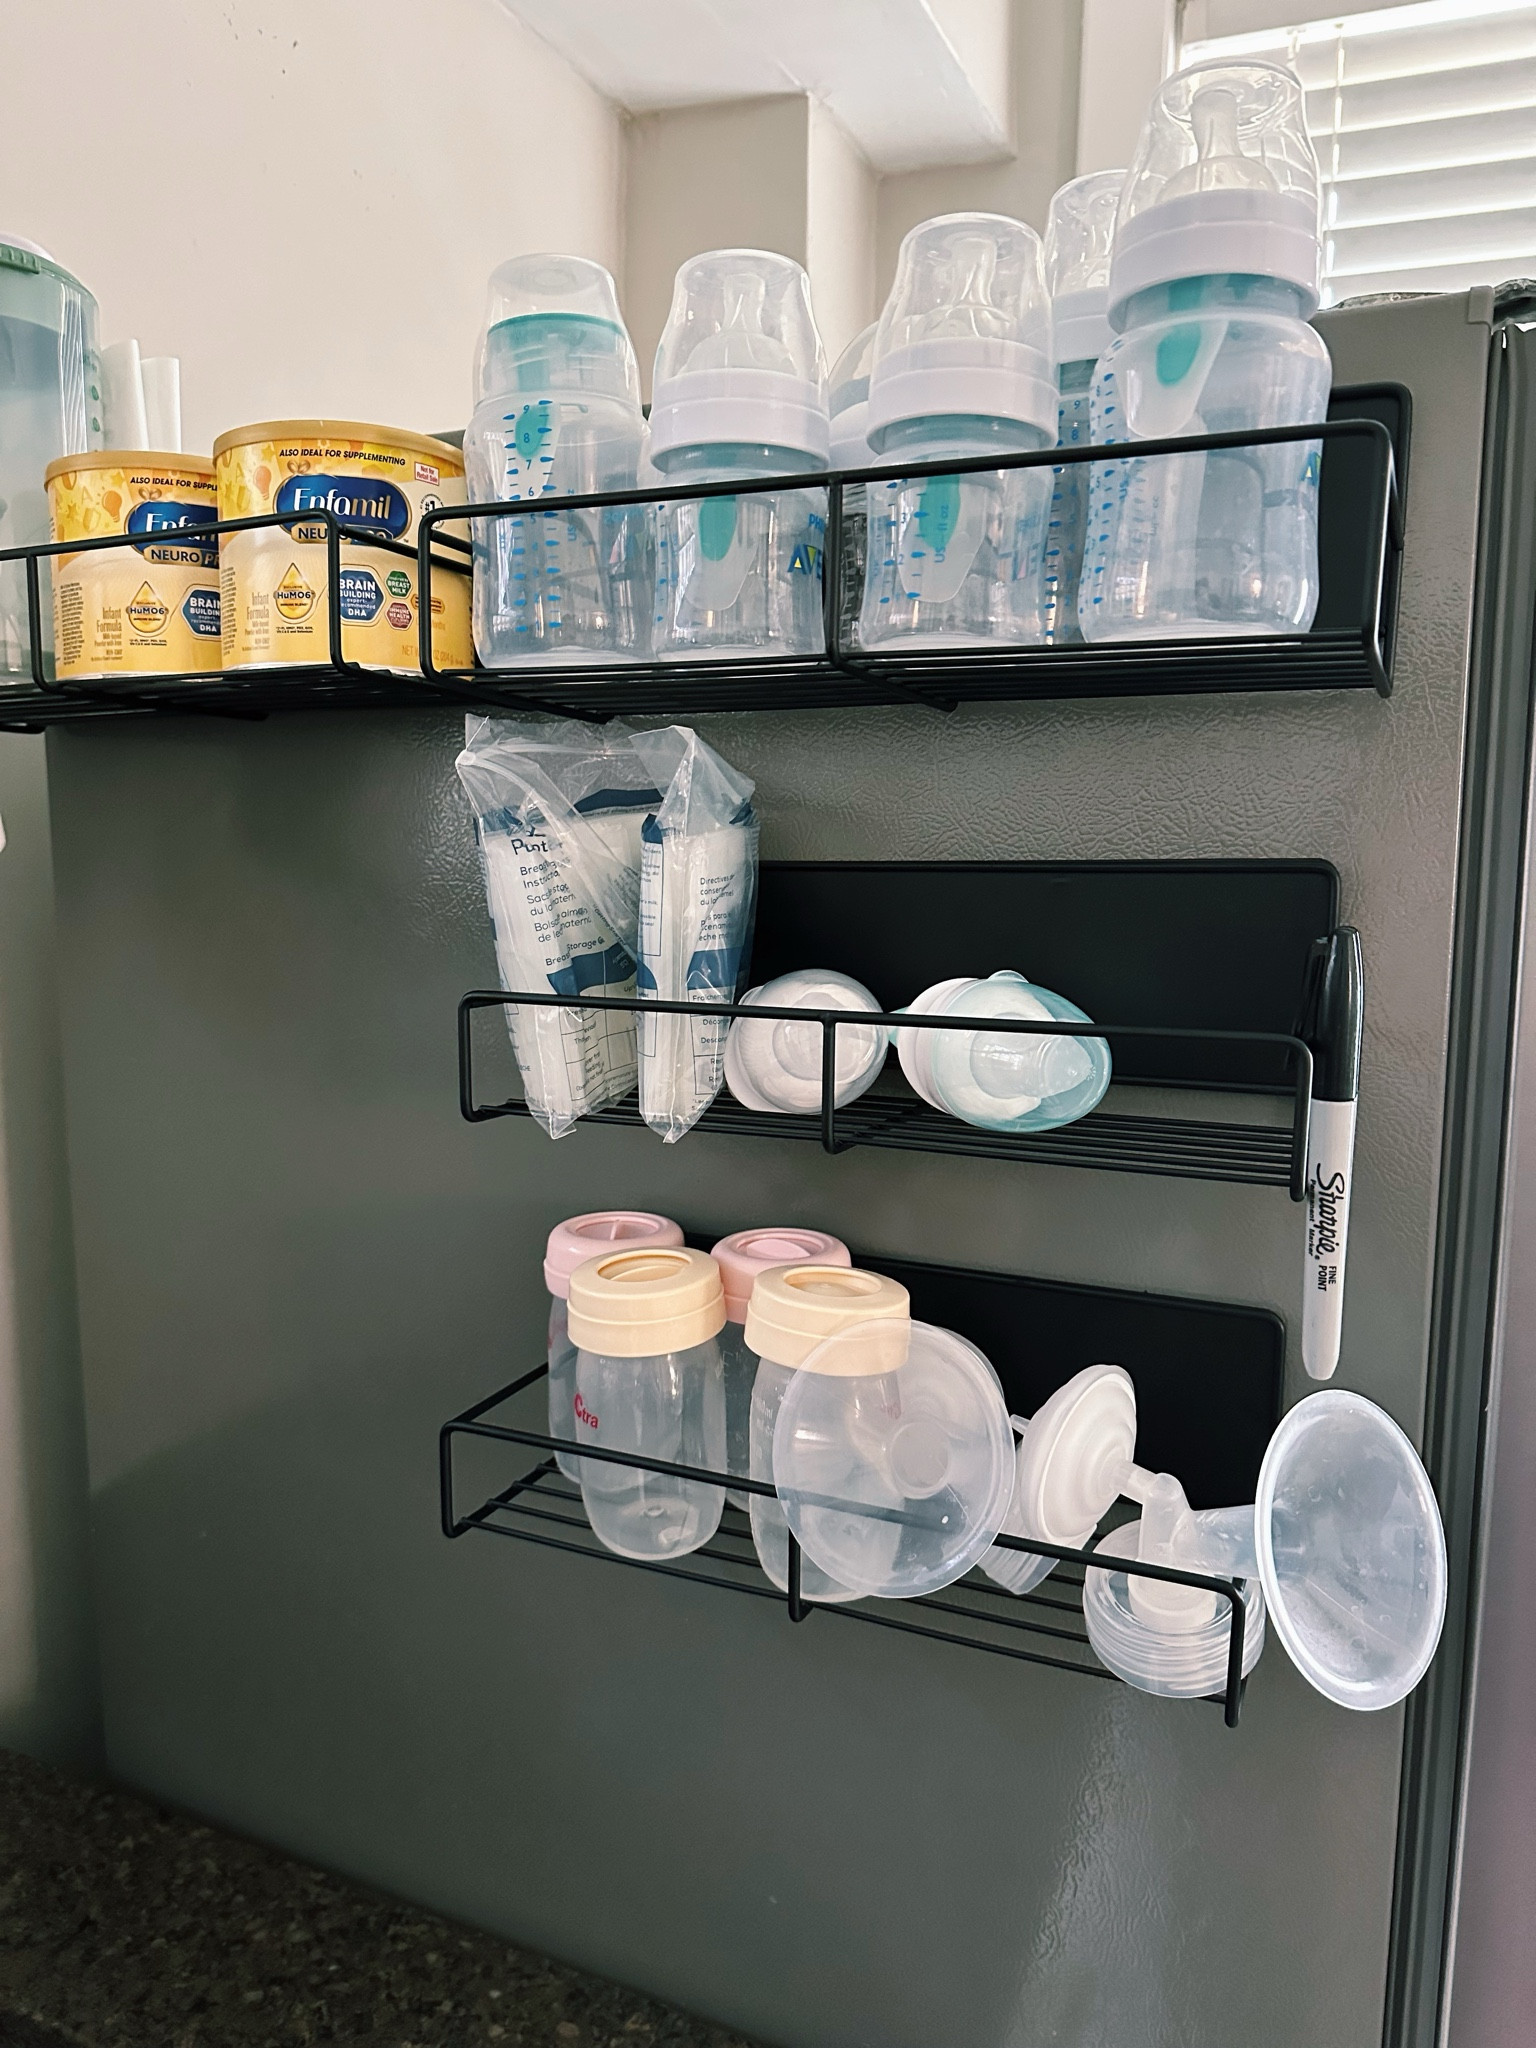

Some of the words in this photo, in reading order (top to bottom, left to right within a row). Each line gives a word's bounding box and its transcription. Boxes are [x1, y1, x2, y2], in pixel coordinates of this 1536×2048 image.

[523, 404, 530, 414] 9
[523, 432, 531, 444] 8
[1071, 428, 1079, 440] 8
[279, 449, 299, 458] ALSO
[301, 448, 323, 457] IDEAL
[325, 449, 341, 458] FOR
[343, 451, 406, 466] SUPPLEMENTING
[525, 459, 532, 470] 7
[130, 476, 151, 485] ALSO
[152, 476, 174, 486] IDEAL
[176, 478, 191, 488] FOR
[528, 486, 535, 497] 6
[293, 488, 391, 520] Enfamil
[151, 549, 200, 563] NEURO
[340, 579, 376, 592] BRAIN
[388, 581, 410, 589] BREAST
[252, 592, 269, 606] Infant
[277, 591, 312, 599] HuMO6
[340, 590, 376, 600] BUILDING
[102, 606, 121, 619] Infant
[130, 607, 165, 615] HuMO6
[246, 605, 269, 620] Formula
[348, 609, 367, 617] DHA
[96, 619, 122, 633] Formula
[199, 624, 217, 632] DHA
[538, 933, 551, 943] de
[1313, 1162, 1345, 1256] Sharpie
[1308, 1228, 1316, 1256] Marker
[1318, 1264, 1328, 1292] POINT
[1328, 1265, 1337, 1285] FINE
